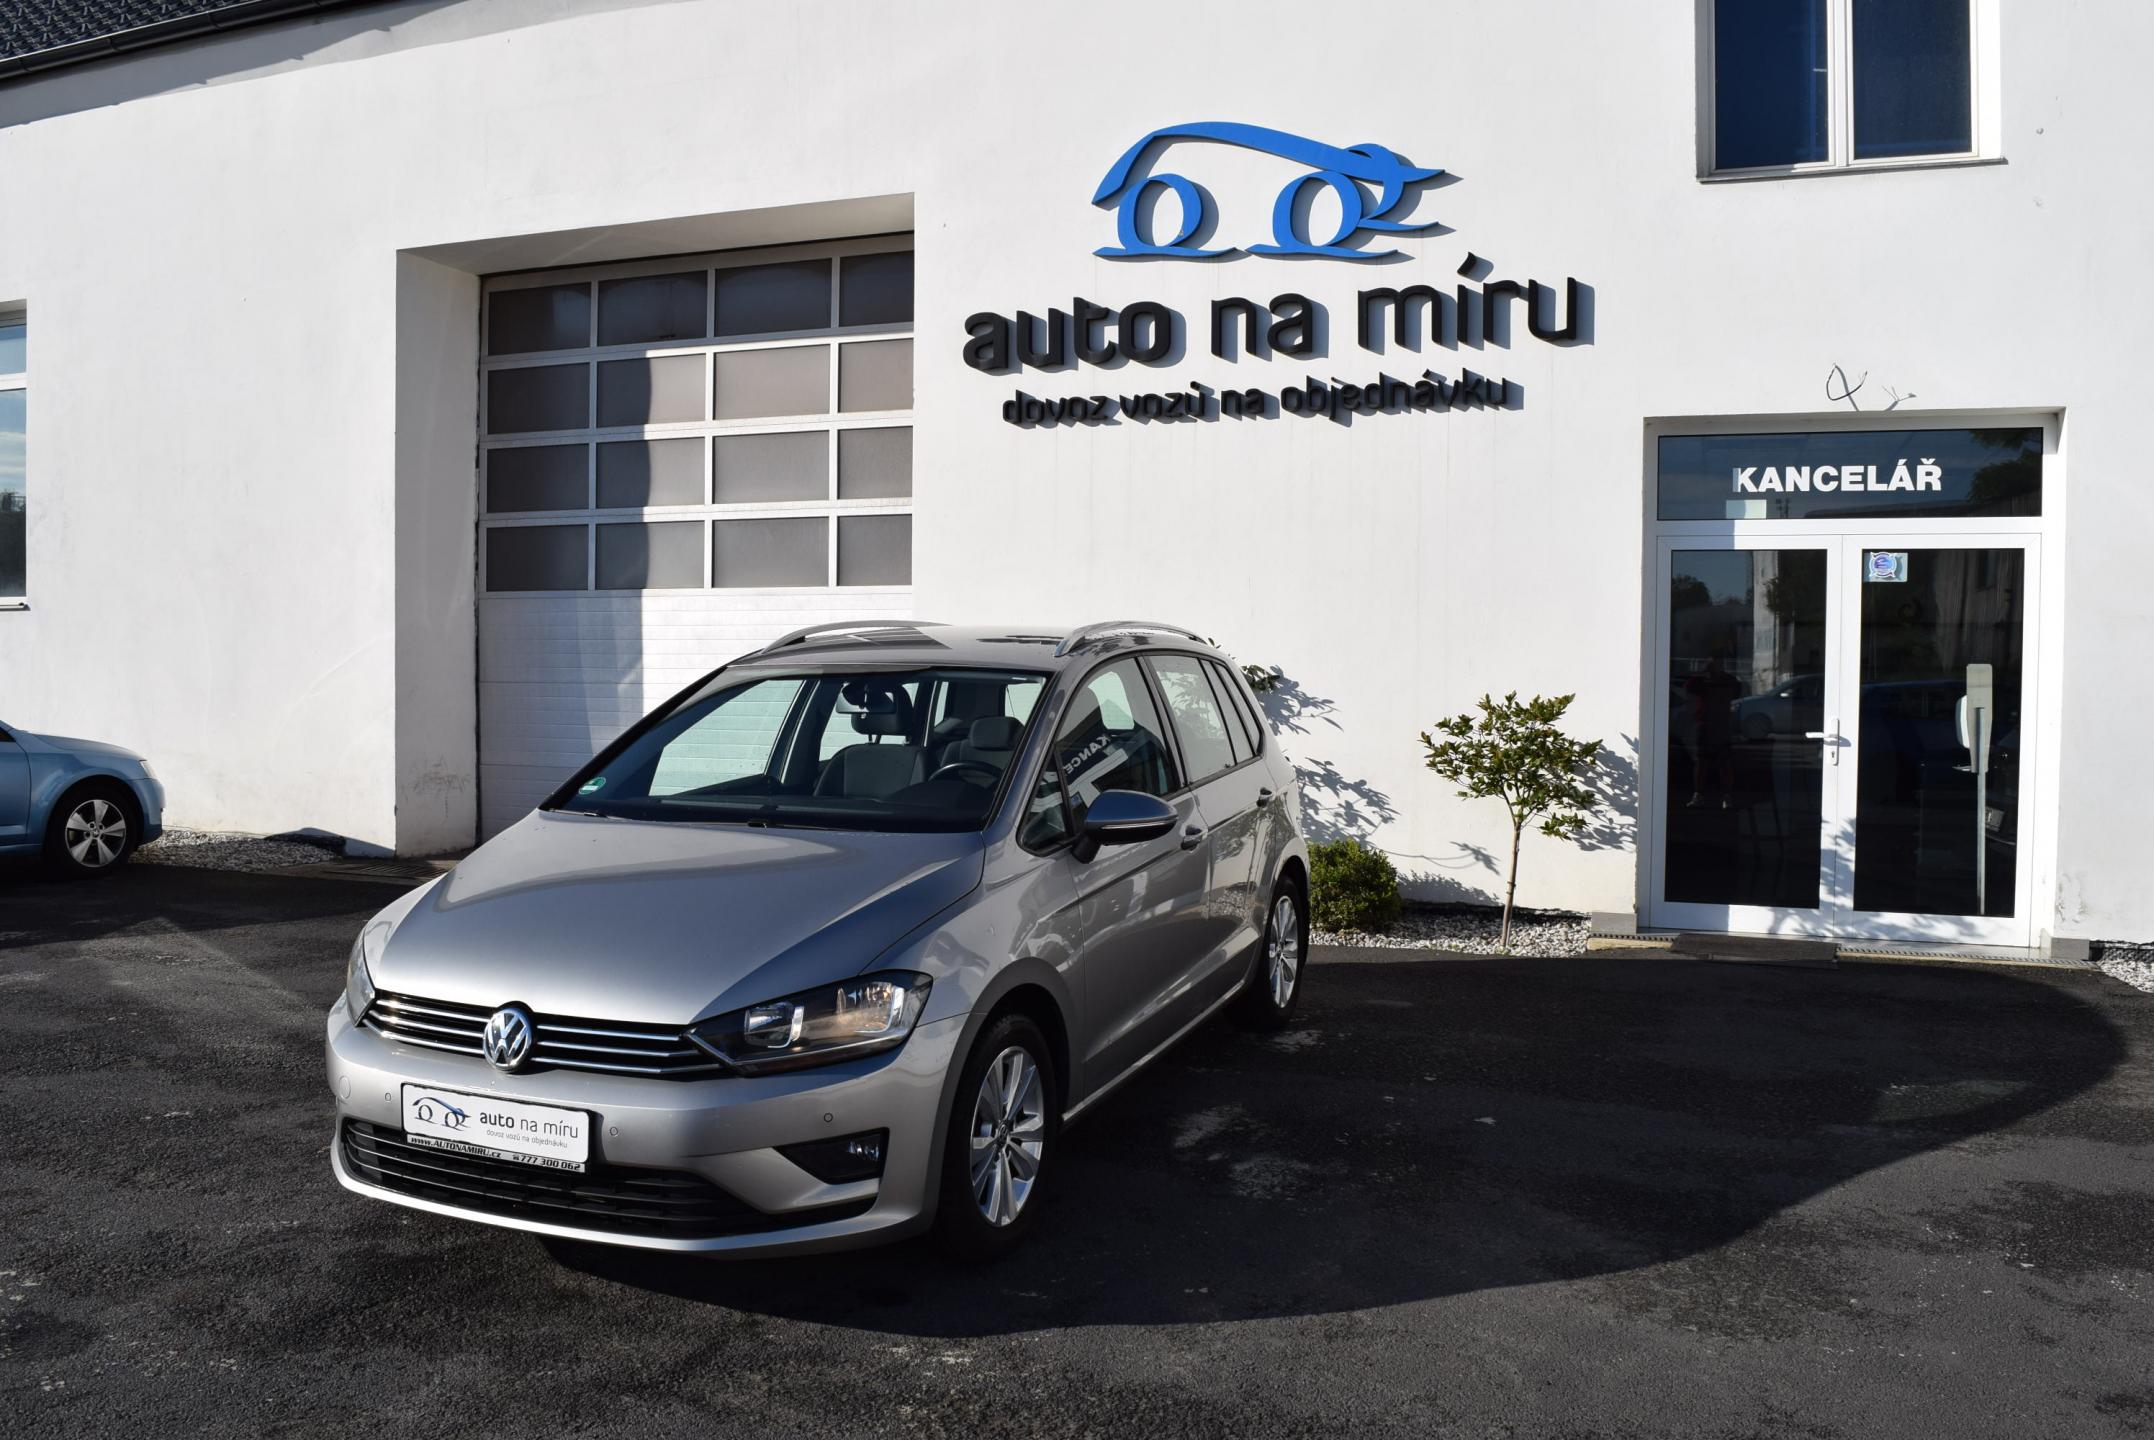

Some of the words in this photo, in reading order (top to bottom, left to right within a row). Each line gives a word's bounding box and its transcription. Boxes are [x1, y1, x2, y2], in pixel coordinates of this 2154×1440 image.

[963, 296, 1172, 371] auto
[1211, 292, 1313, 358] na
[1358, 251, 1578, 351] míru
[1002, 389, 1110, 425] dovoz
[1221, 387, 1266, 416] na
[1280, 367, 1508, 422] objednávku
[1732, 457, 1943, 494] KANCELÁŘ
[479, 1111, 515, 1129] auto
[520, 1118, 538, 1133] na
[543, 1120, 578, 1139] míru
[520, 1154, 538, 1165] 777
[540, 1158, 559, 1169] 300
[560, 1161, 581, 1171] 062
